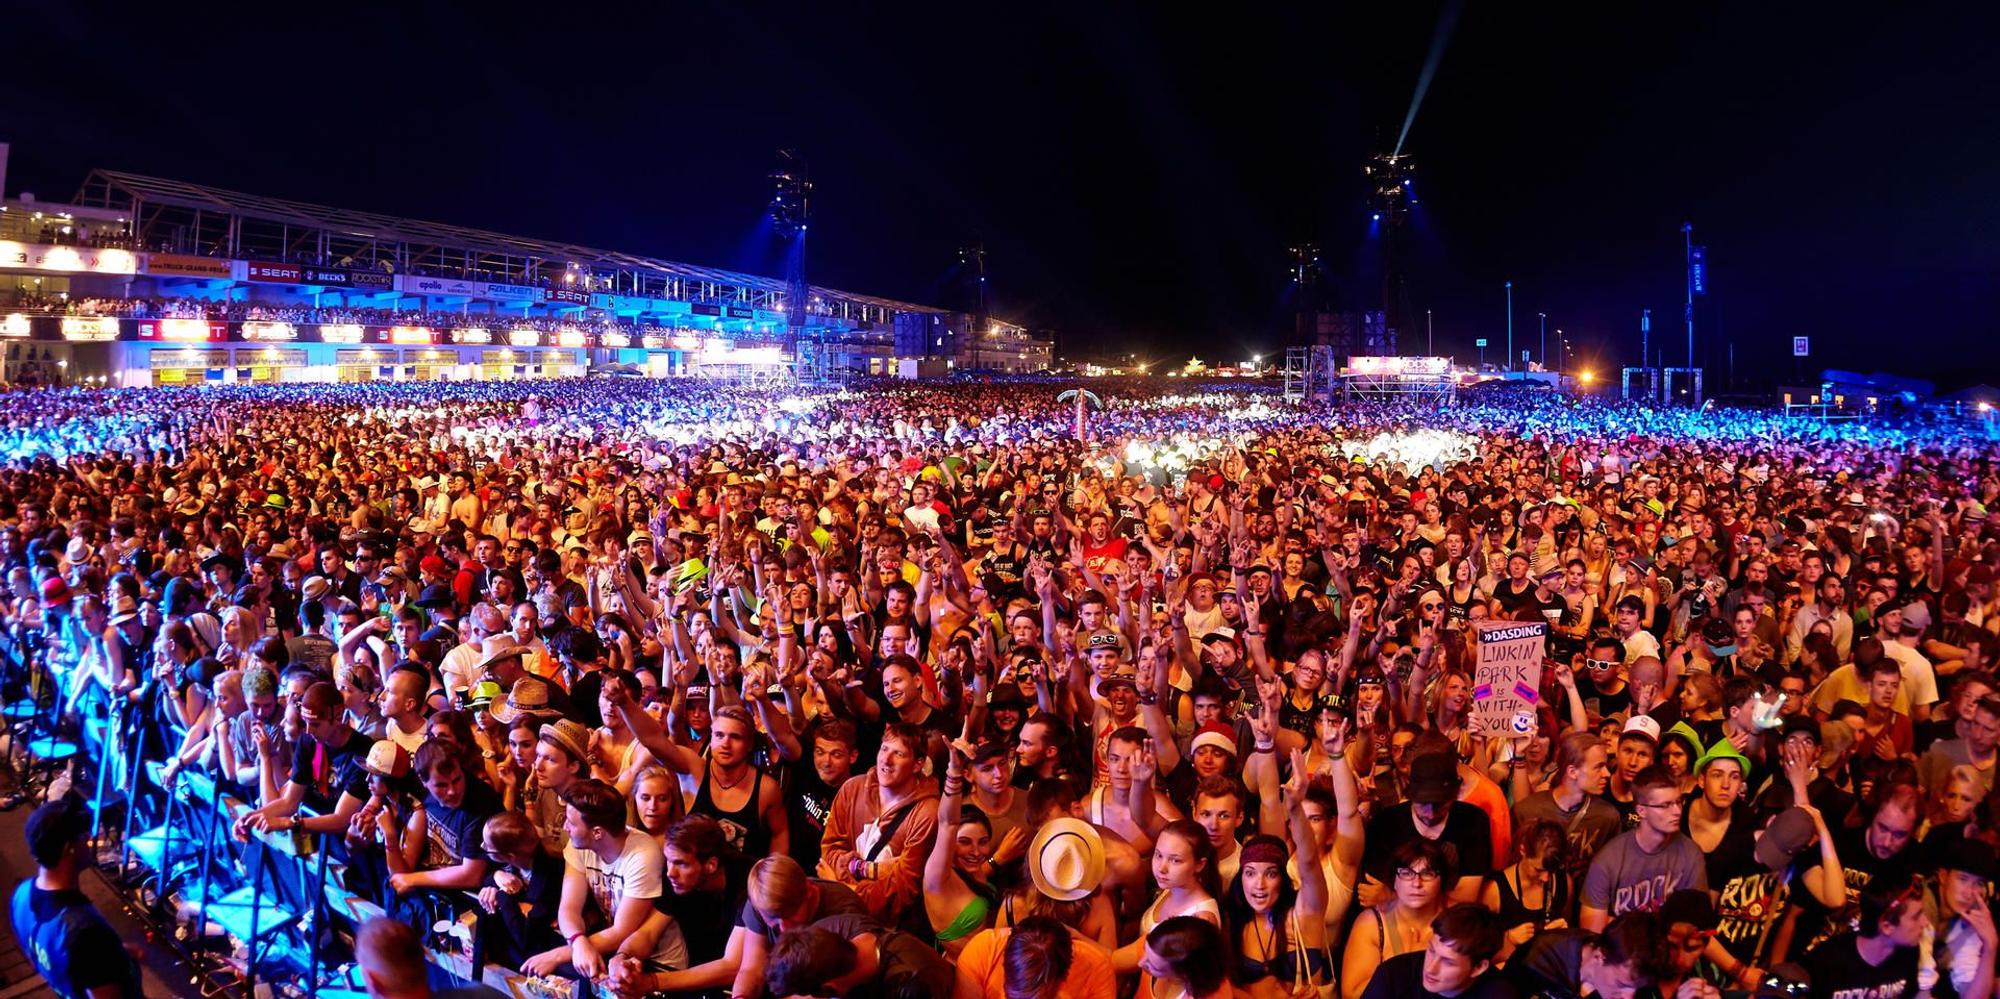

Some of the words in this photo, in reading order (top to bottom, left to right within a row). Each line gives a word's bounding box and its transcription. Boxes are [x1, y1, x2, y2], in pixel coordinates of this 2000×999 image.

[262, 268, 299, 279] SEAT
[419, 280, 442, 290] apollo
[487, 284, 533, 296] FALKEN
[556, 290, 590, 303] SEAT
[1482, 641, 1536, 663] LINKIN
[1477, 665, 1528, 684] PARK
[1482, 717, 1511, 731] YOU
